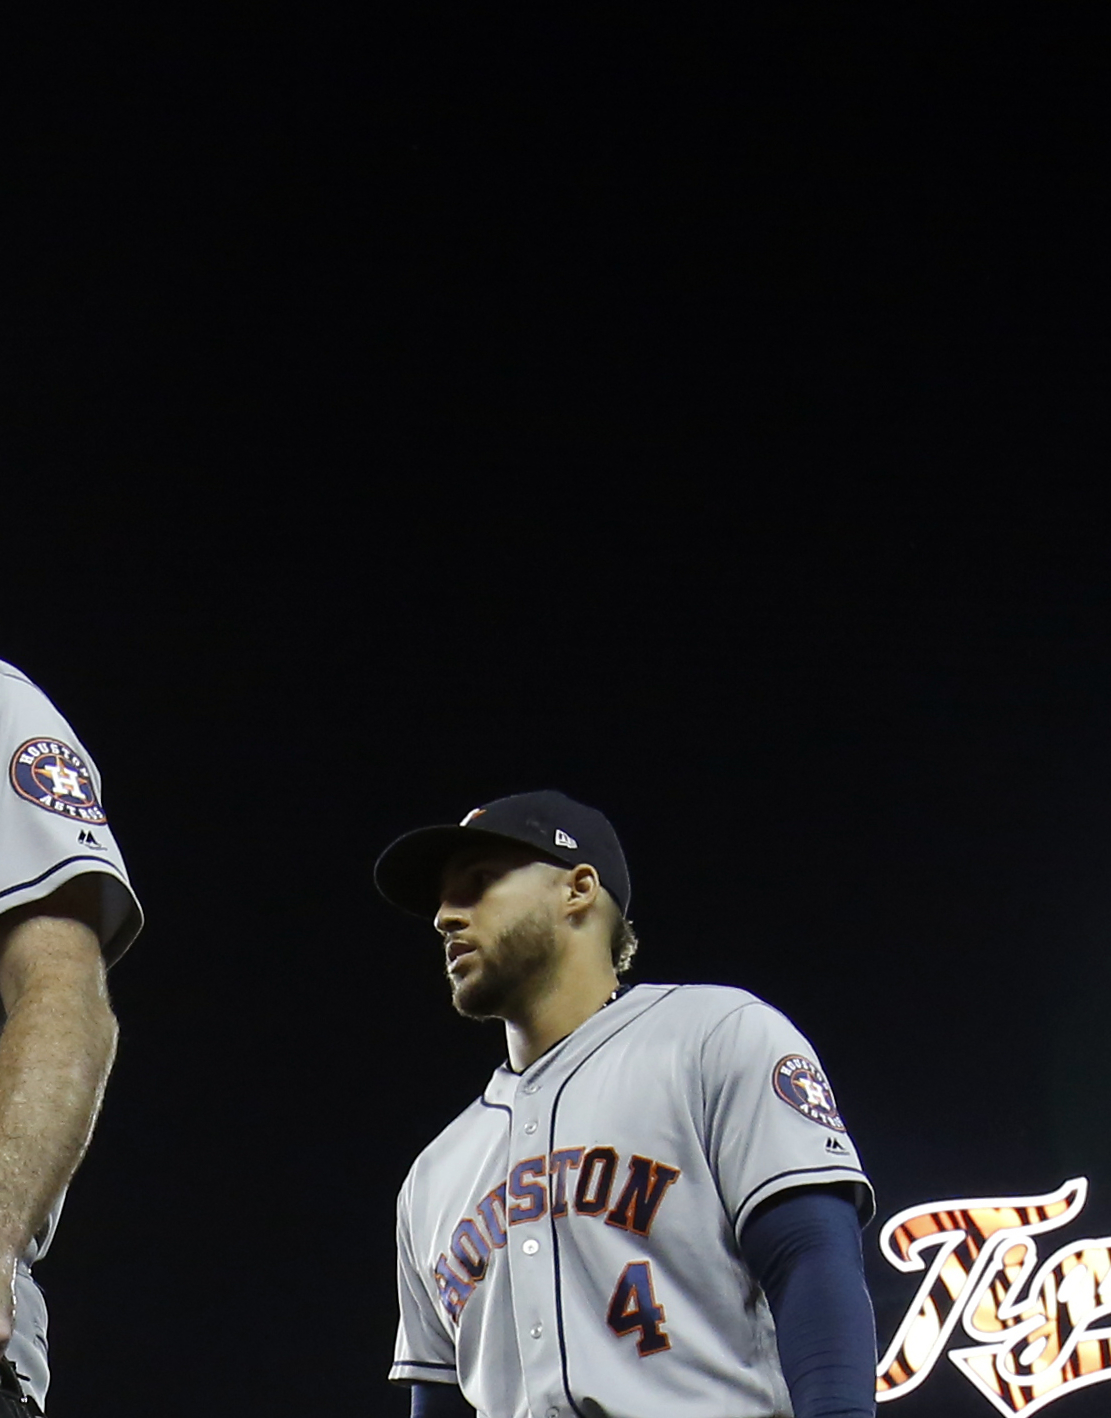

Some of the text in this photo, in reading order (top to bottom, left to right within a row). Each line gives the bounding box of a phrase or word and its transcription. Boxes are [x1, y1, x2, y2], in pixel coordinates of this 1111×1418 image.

[18, 742, 89, 777] HOUSTON
[435, 1146, 680, 1326] HOUSTON
[607, 1260, 671, 1358] 4
